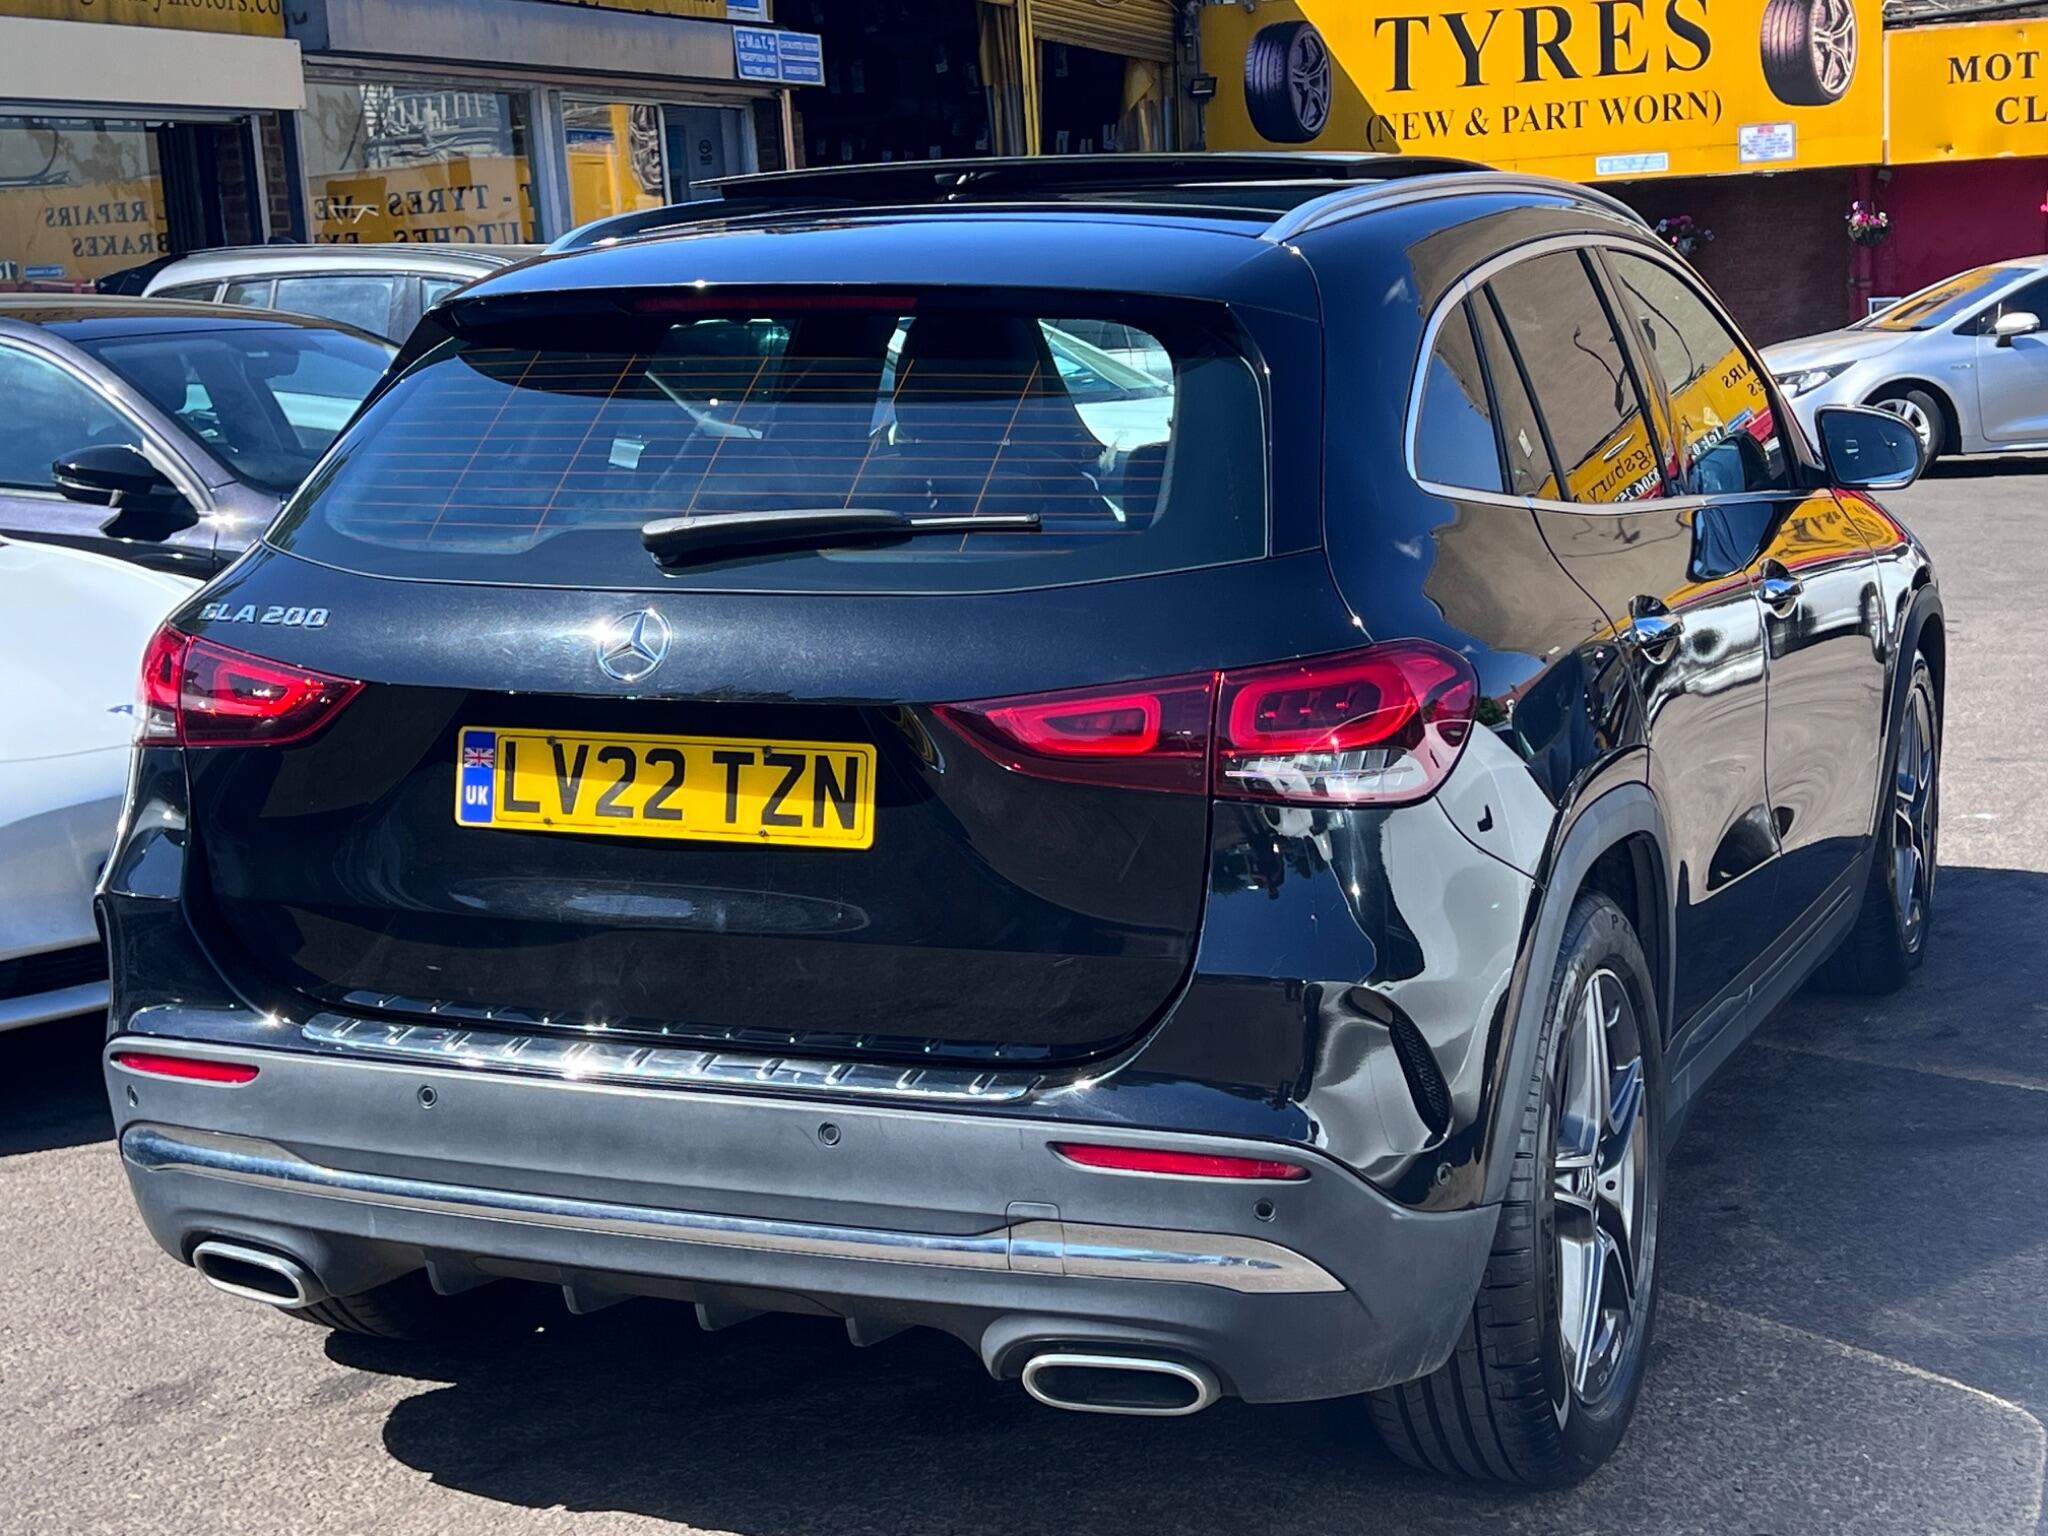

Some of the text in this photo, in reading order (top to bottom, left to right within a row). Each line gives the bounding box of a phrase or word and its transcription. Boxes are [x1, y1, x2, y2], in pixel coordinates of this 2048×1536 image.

[1374, 0, 1712, 93] TYRES
[1946, 51, 2040, 84] MOT
[1366, 89, 1723, 151] (NEW & PART WORN)
[1995, 95, 2048, 125] CL
[198, 602, 330, 629] GLA 200
[466, 784, 489, 806] UK
[504, 741, 859, 831] LV22 TZN
